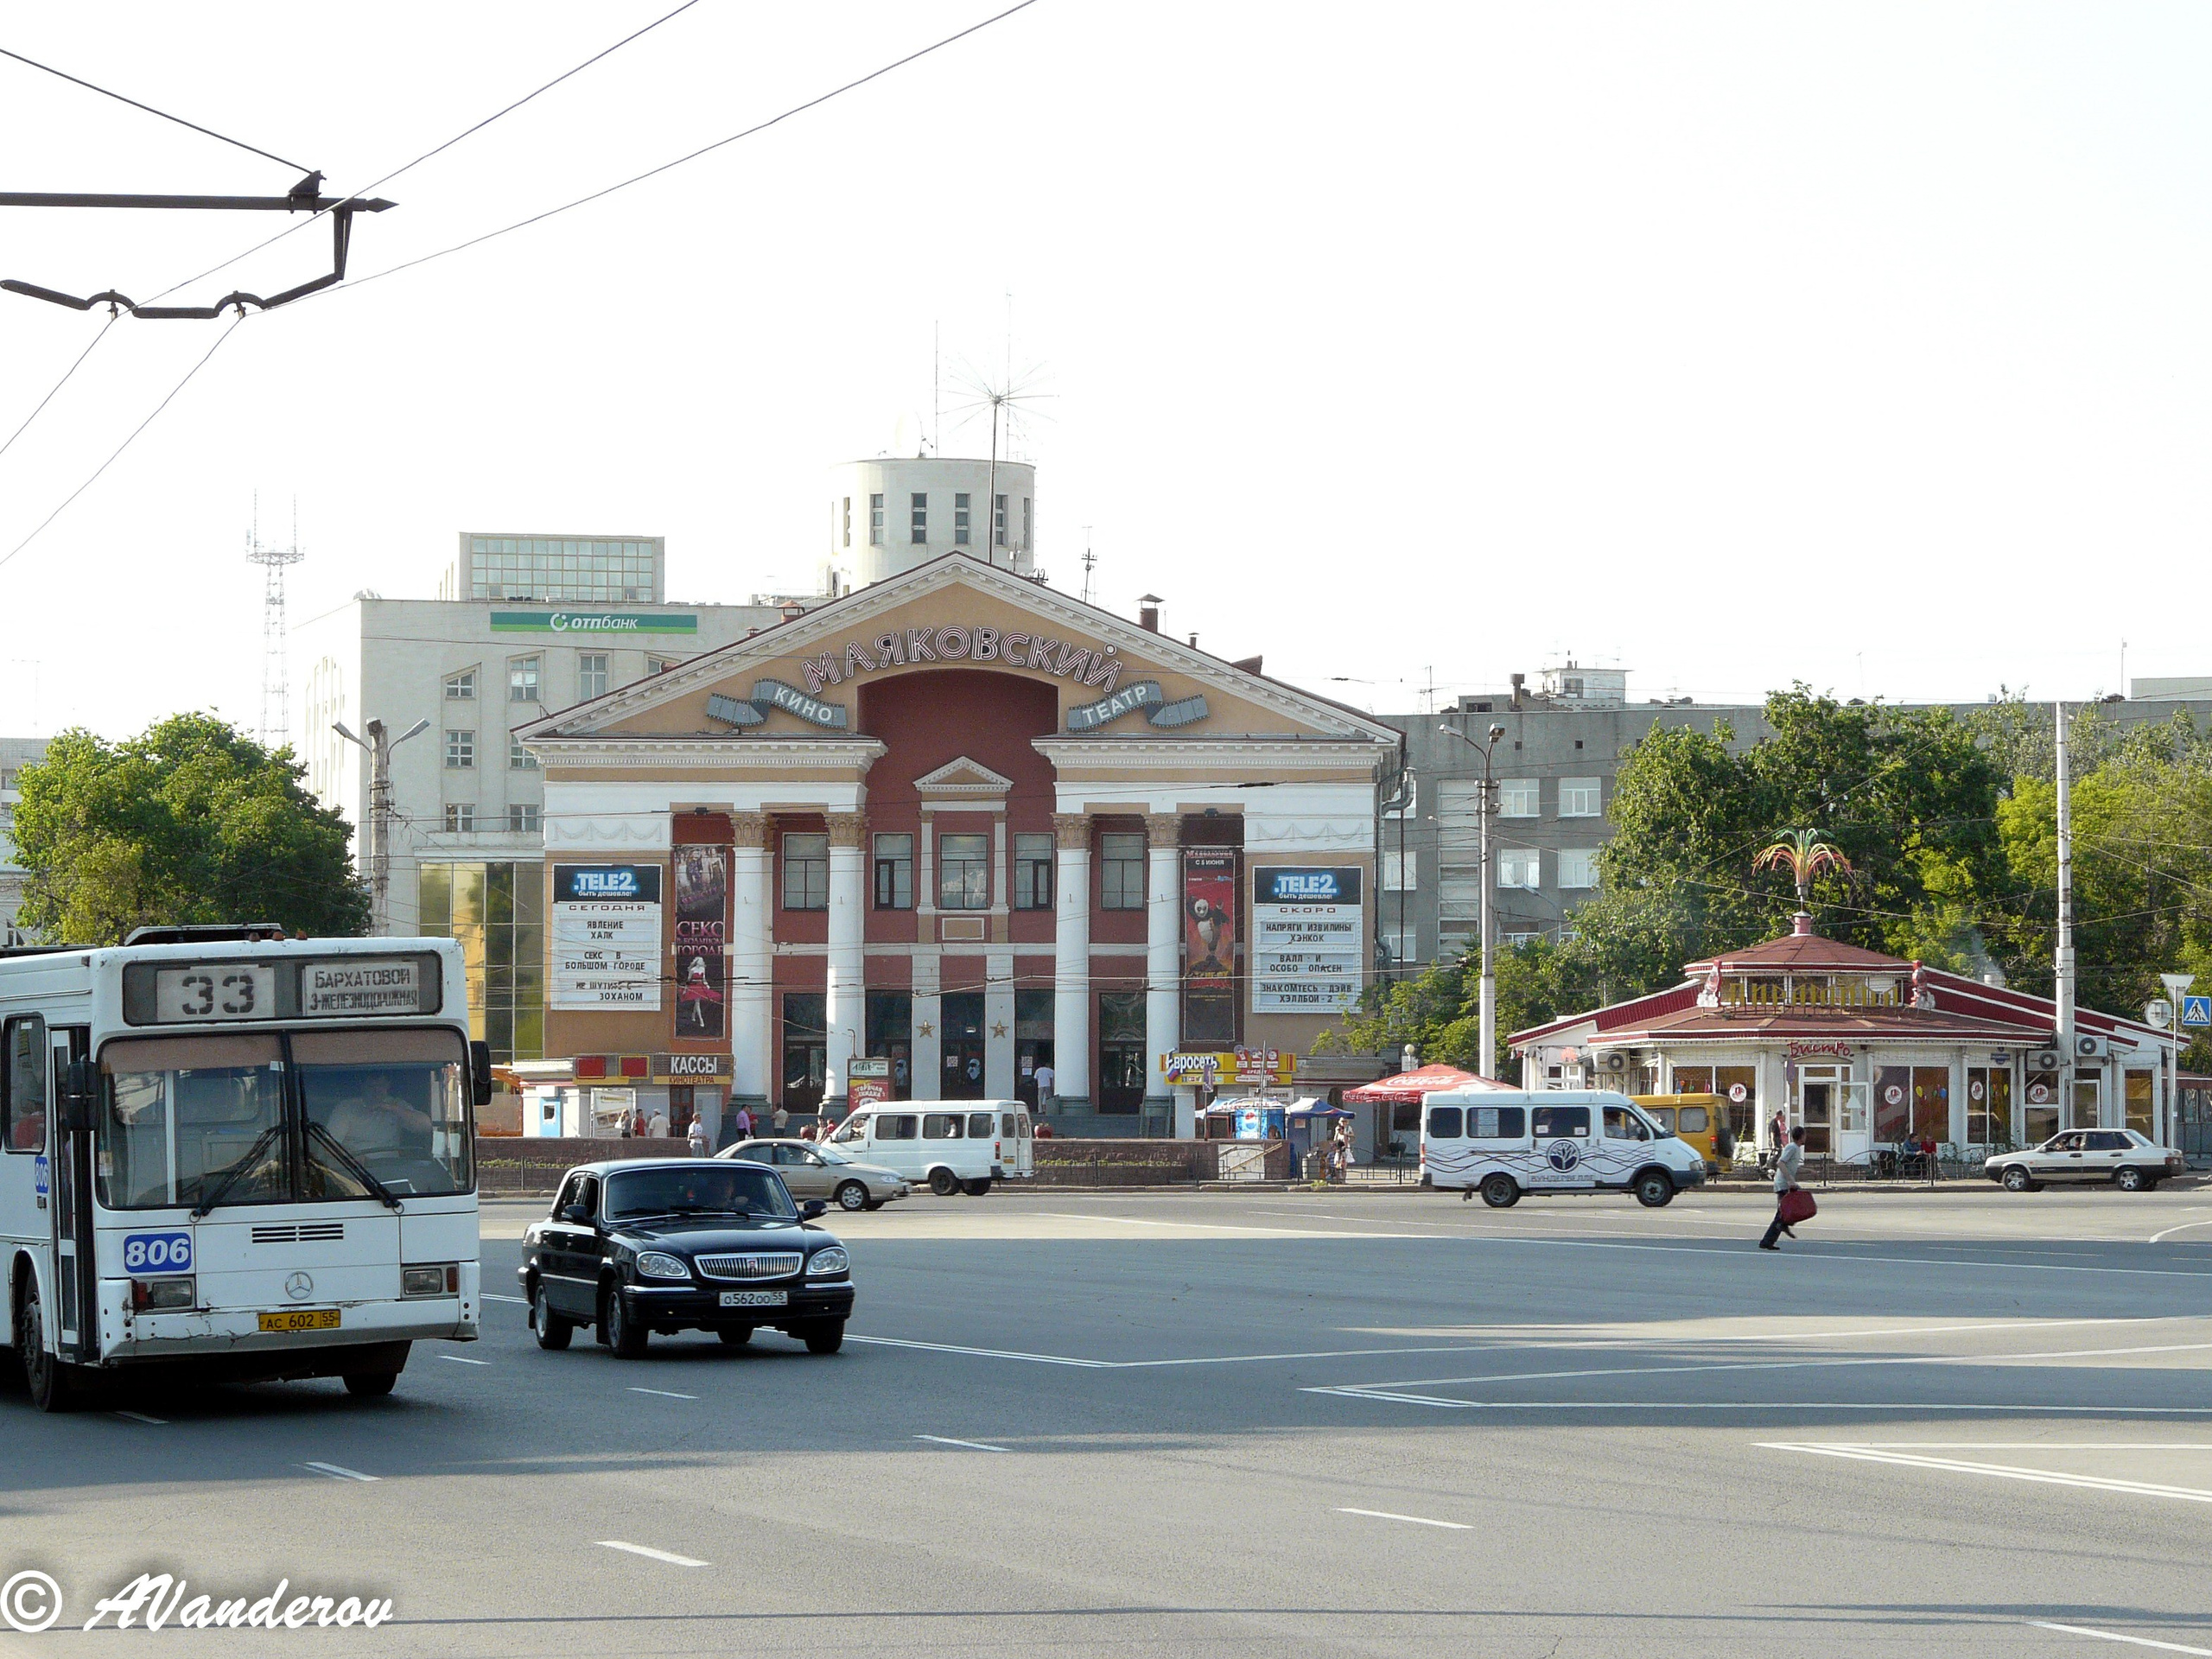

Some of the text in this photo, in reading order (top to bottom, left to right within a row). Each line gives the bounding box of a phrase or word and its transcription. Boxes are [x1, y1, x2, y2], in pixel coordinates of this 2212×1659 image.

[801, 626, 1123, 693] МАЯКОВСКИЙ
[773, 687, 833, 722] КИНО
[1082, 685, 1148, 725] ТЕАТР
[587, 920, 624, 929] ЯВЛЕНИЕ
[677, 920, 724, 938] СЕКС
[1307, 924, 1351, 932] ИЗВИЛИНЫ
[591, 931, 613, 940] ХАЛК
[677, 944, 724, 957] ГОРОДЕ
[613, 962, 645, 970] ГОРОДЕ
[315, 969, 410, 988] БАРХАТОВОЙ
[181, 976, 254, 1015] 33
[1787, 1041, 1851, 1057] Бистро
[671, 1056, 717, 1074] КАССЫ
[669, 1076, 715, 1084] КИНОТЕАТРА
[125, 1238, 189, 1267] 806
[289, 1314, 314, 1328] 602
[322, 1312, 334, 1322] 55
